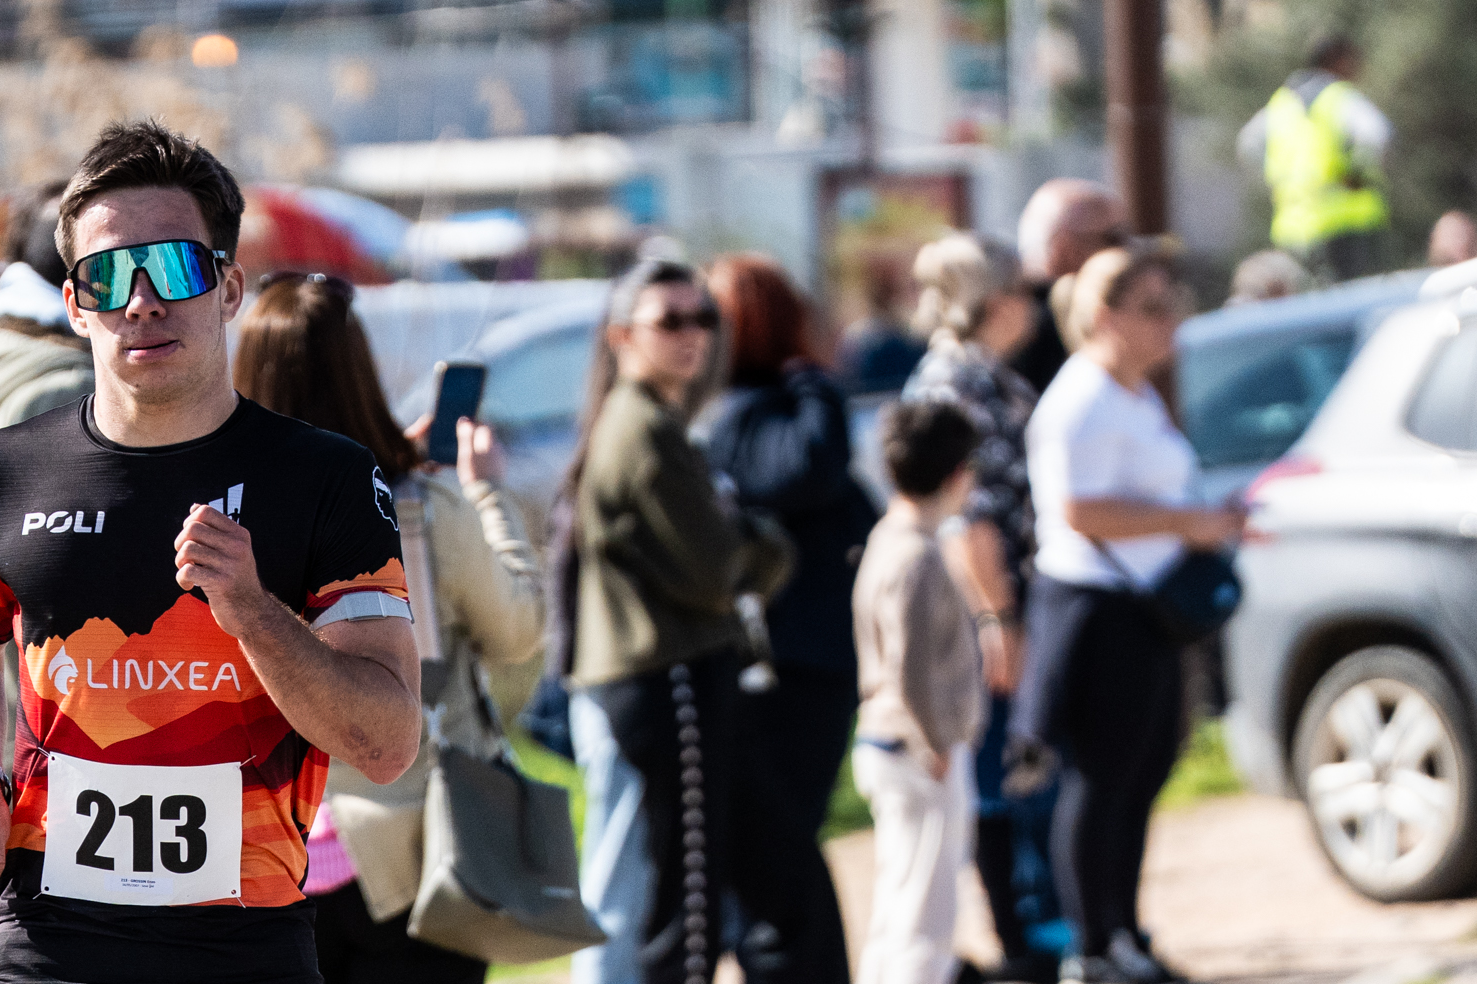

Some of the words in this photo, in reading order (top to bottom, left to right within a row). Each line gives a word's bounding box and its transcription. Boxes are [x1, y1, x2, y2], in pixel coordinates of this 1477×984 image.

[22, 510, 105, 535] POLI
[87, 658, 241, 691] LINXEA
[76, 789, 207, 874] 213
